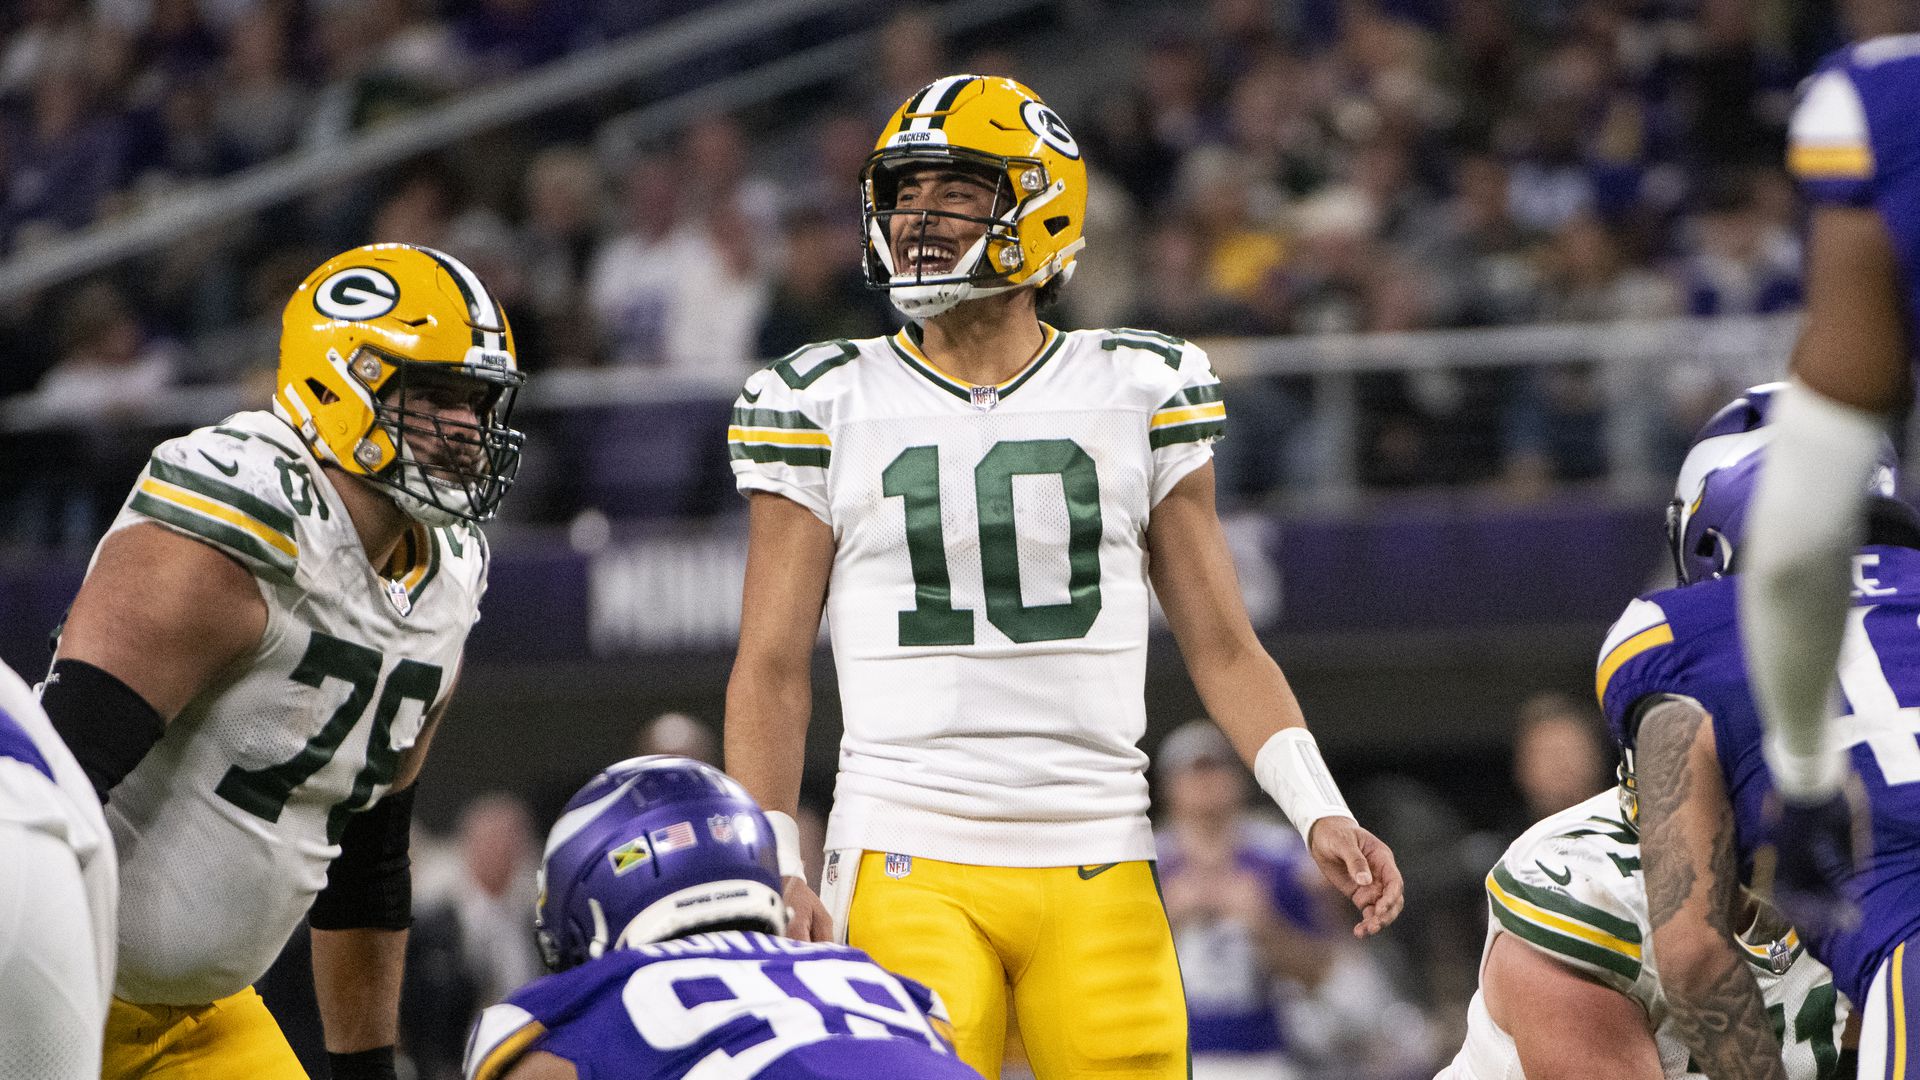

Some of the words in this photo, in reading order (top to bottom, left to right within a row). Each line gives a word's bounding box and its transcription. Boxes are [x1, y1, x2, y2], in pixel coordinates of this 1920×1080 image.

[898, 131, 931, 143] PACKERS
[315, 267, 397, 319] G
[881, 438, 1103, 646] 10
